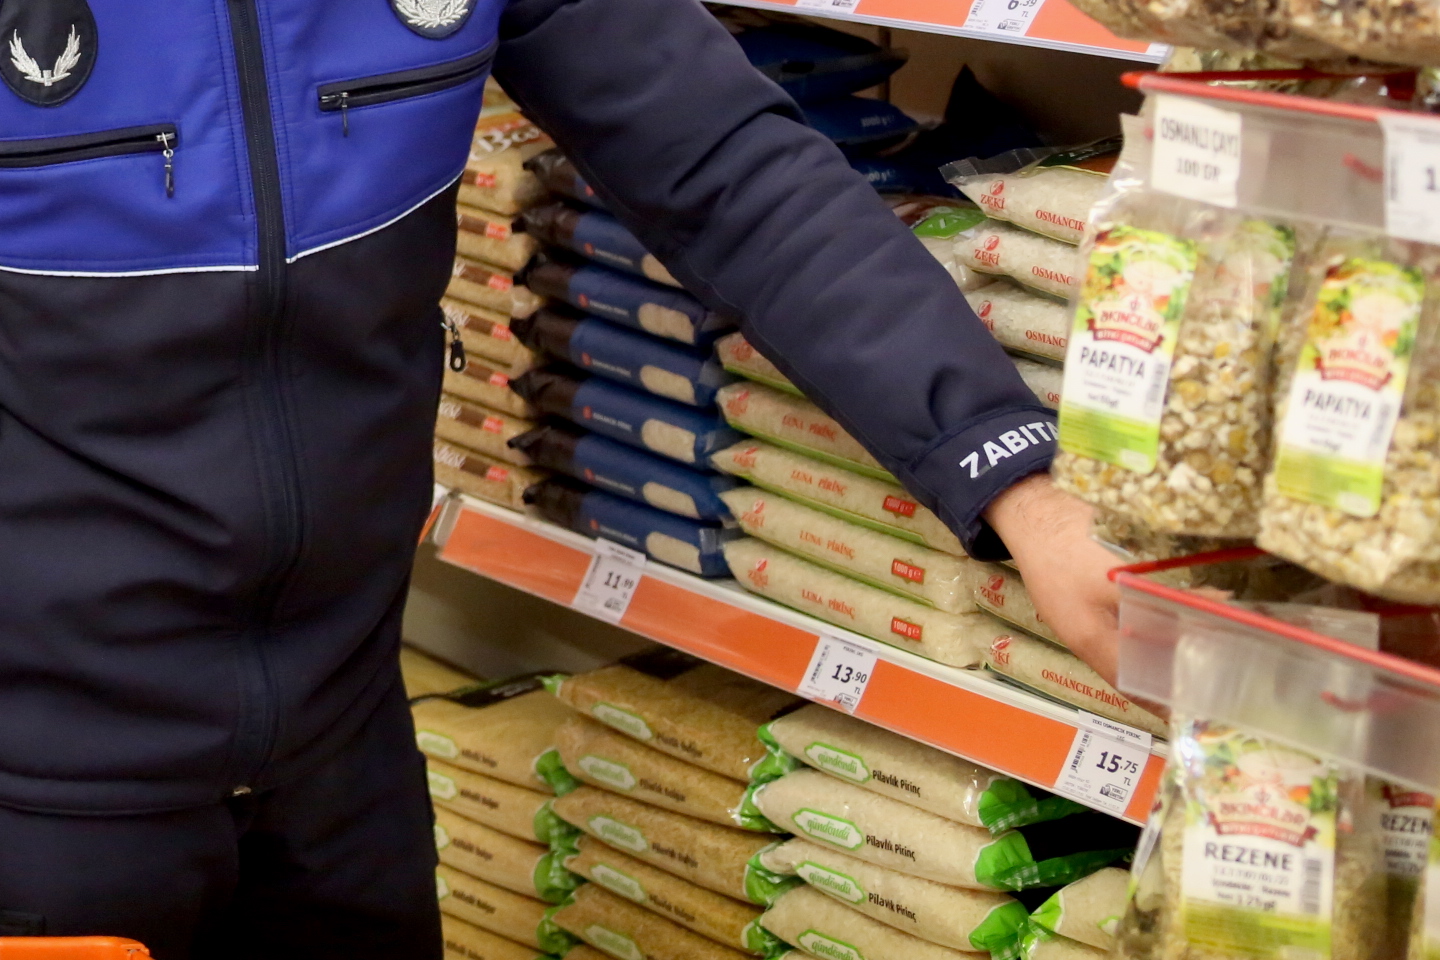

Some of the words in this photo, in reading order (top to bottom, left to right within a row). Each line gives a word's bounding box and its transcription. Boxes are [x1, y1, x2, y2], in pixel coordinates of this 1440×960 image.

[1021, 10, 1029, 18] TL
[1160, 117, 1208, 143] OSMANLI
[1176, 156, 1200, 177] 100
[980, 193, 1005, 210] ZEKİ
[1035, 208, 1086, 233] OSMANCIK
[974, 248, 1000, 266] ZEKİ
[1025, 329, 1066, 349] OSMANC
[1080, 346, 1145, 379] PAPATYA
[1303, 388, 1372, 421] PAPATYA
[959, 421, 1059, 479] ZABITA
[791, 469, 813, 485] LUNA
[818, 477, 848, 497] PİRİNÇ
[799, 530, 822, 547] LUNA
[826, 538, 855, 560] PİRİNÇ
[893, 559, 907, 573] 1000
[604, 571, 635, 589] 11.99
[802, 589, 823, 605] LUNA
[828, 597, 855, 621] PİRİNÇ
[980, 585, 1005, 607] ZEKİ
[893, 618, 906, 631] 1000
[831, 663, 867, 684] 13.90
[854, 686, 861, 695] TL
[1041, 668, 1094, 698] OSMANCIK
[1095, 688, 1130, 713] PİRİNÇ
[1103, 721, 1126, 735] OSMANCIK
[817, 751, 858, 775] gündöndü
[1095, 750, 1139, 774] 15.75
[872, 769, 899, 788] Pilavlık
[900, 778, 921, 798] Pirinç
[1123, 776, 1131, 787] TL
[806, 816, 851, 842] gündöndü
[1381, 812, 1433, 834] REZEN
[866, 834, 894, 853] Pilavlık
[894, 843, 916, 862] Pirinç
[1204, 841, 1295, 872] REZENE
[808, 869, 852, 895] gündöndü
[896, 903, 917, 923] Pirinç
